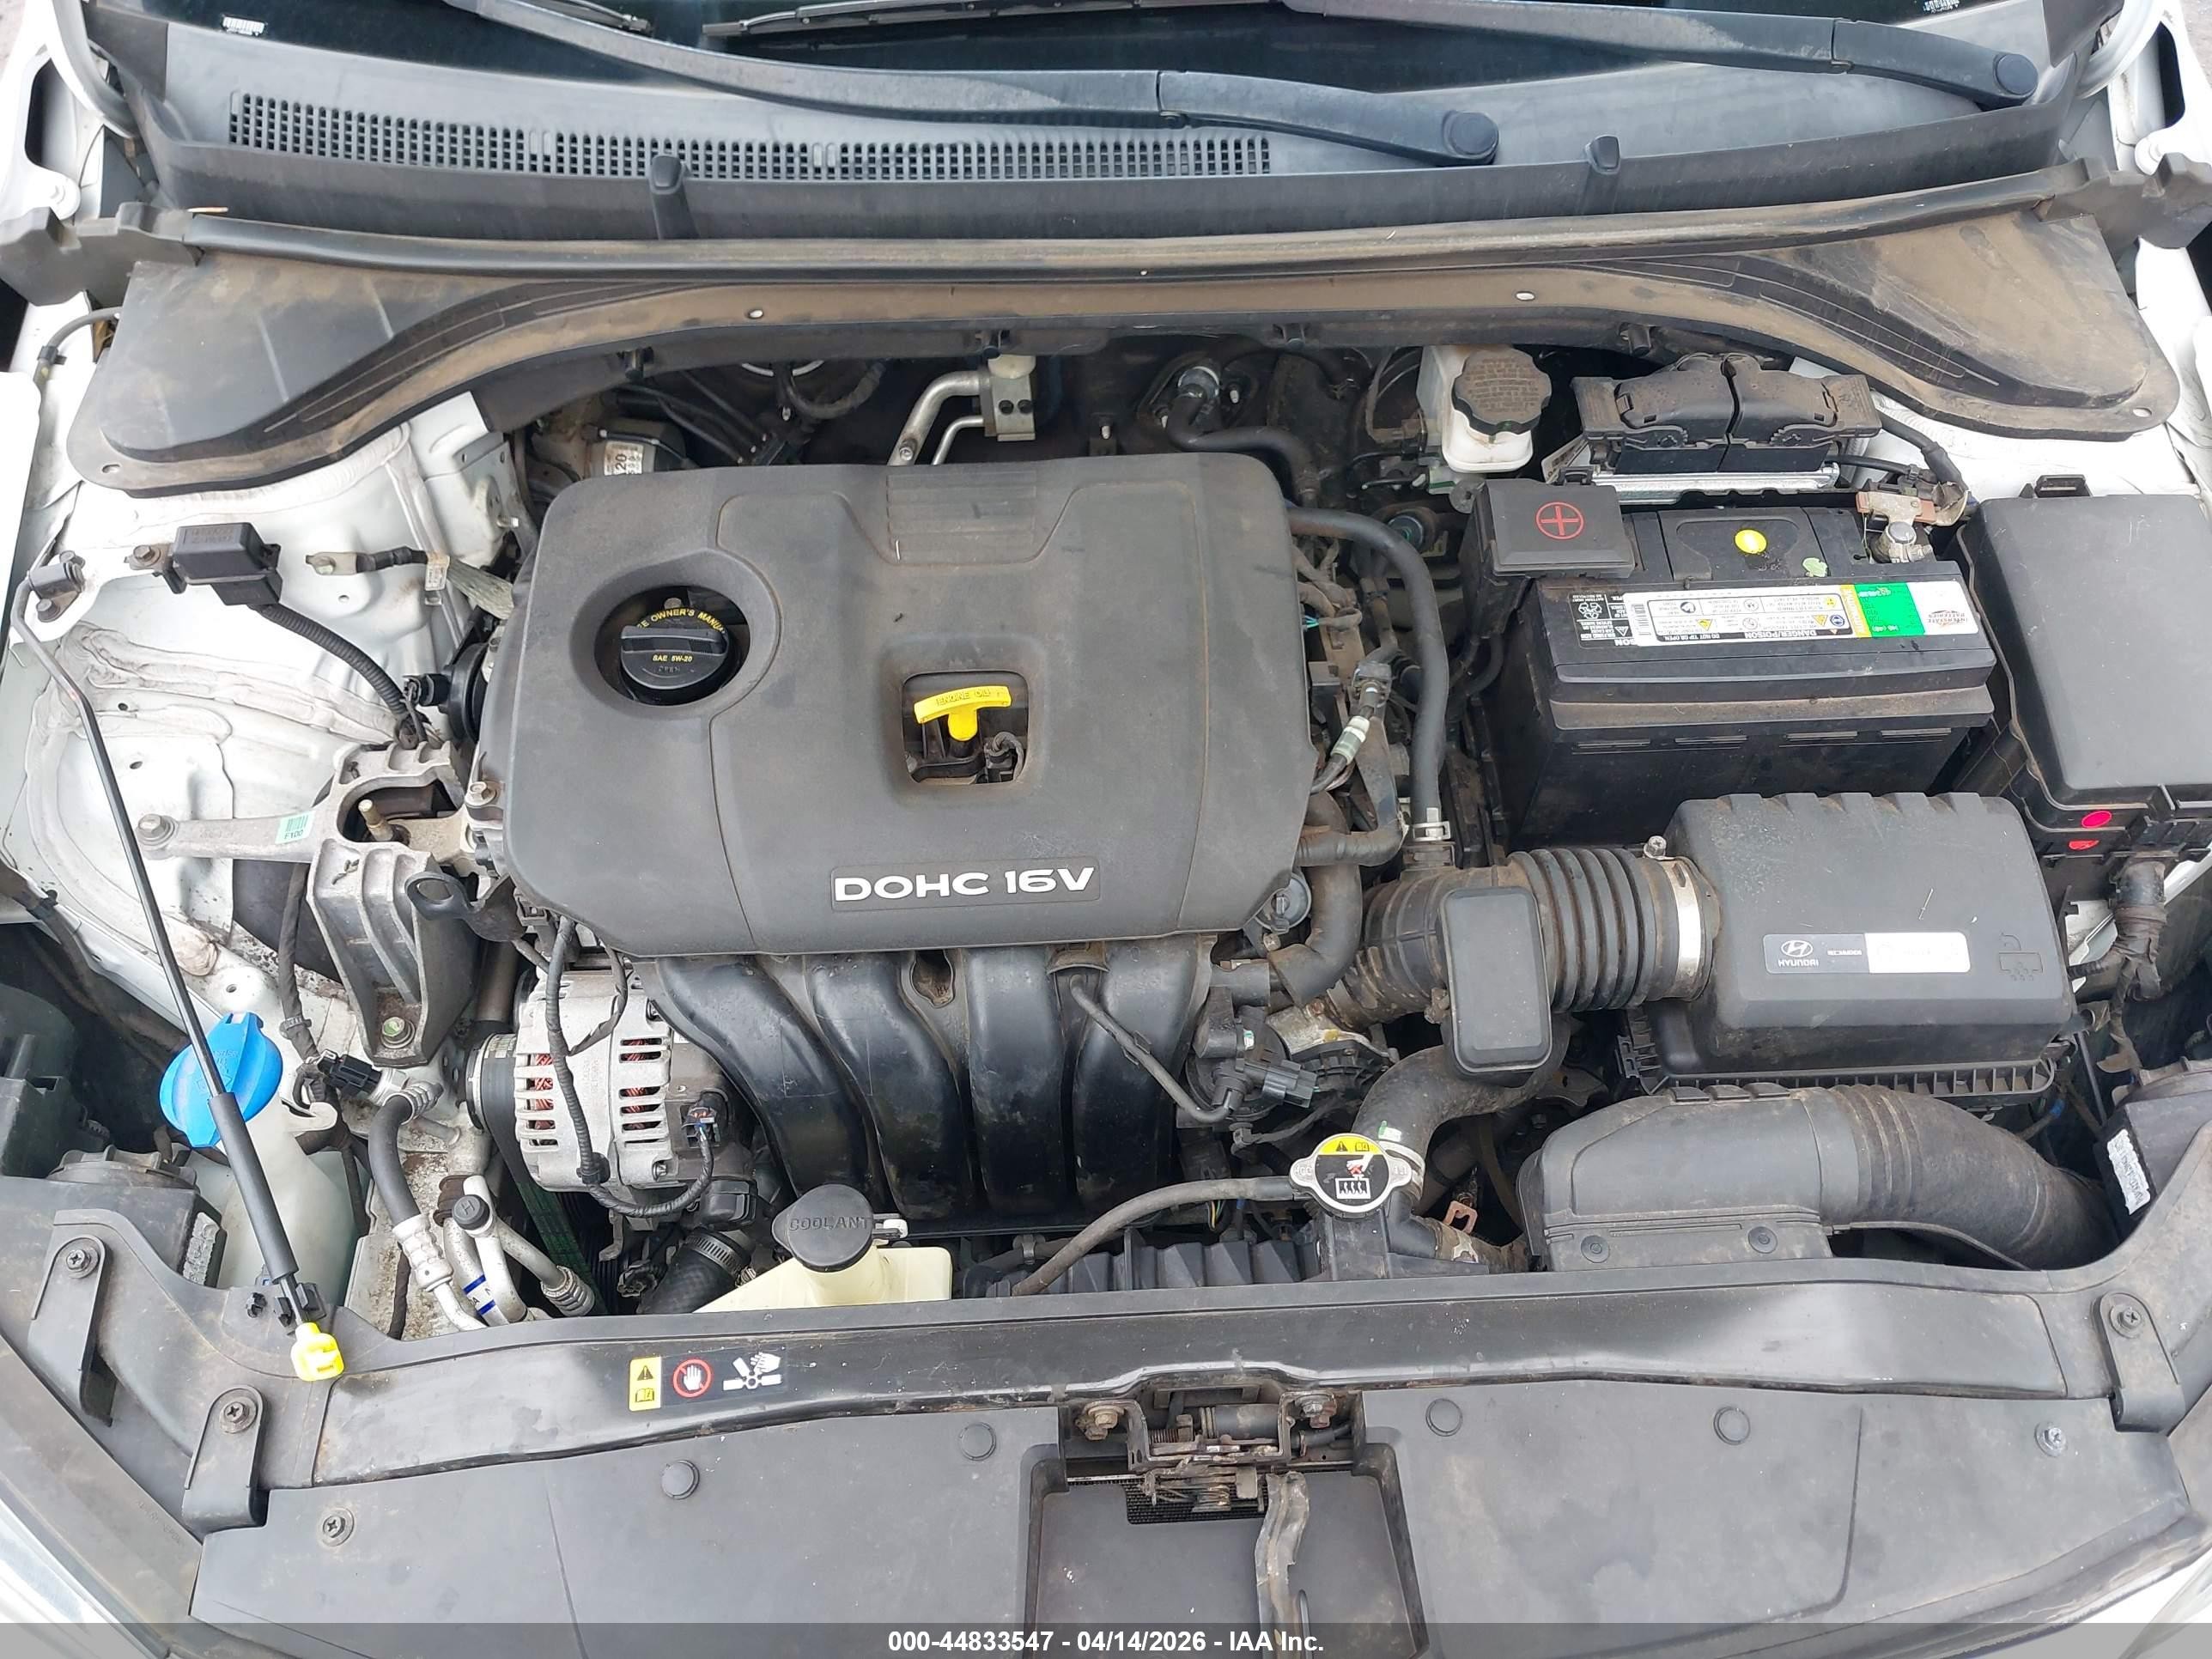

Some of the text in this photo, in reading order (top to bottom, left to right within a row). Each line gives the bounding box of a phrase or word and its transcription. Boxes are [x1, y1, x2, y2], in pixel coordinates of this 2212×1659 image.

[636, 620, 649, 629] EE
[651, 608, 696, 622] OWNER'S
[1744, 629, 1817, 639] DANGER/POISON
[671, 654, 693, 663] 5W-20
[935, 691, 969, 706] ENGINE
[835, 866, 1095, 902] DOHC 16V
[1778, 958, 1820, 967] HYUNDAI
[789, 1216, 871, 1231] COOLANT
